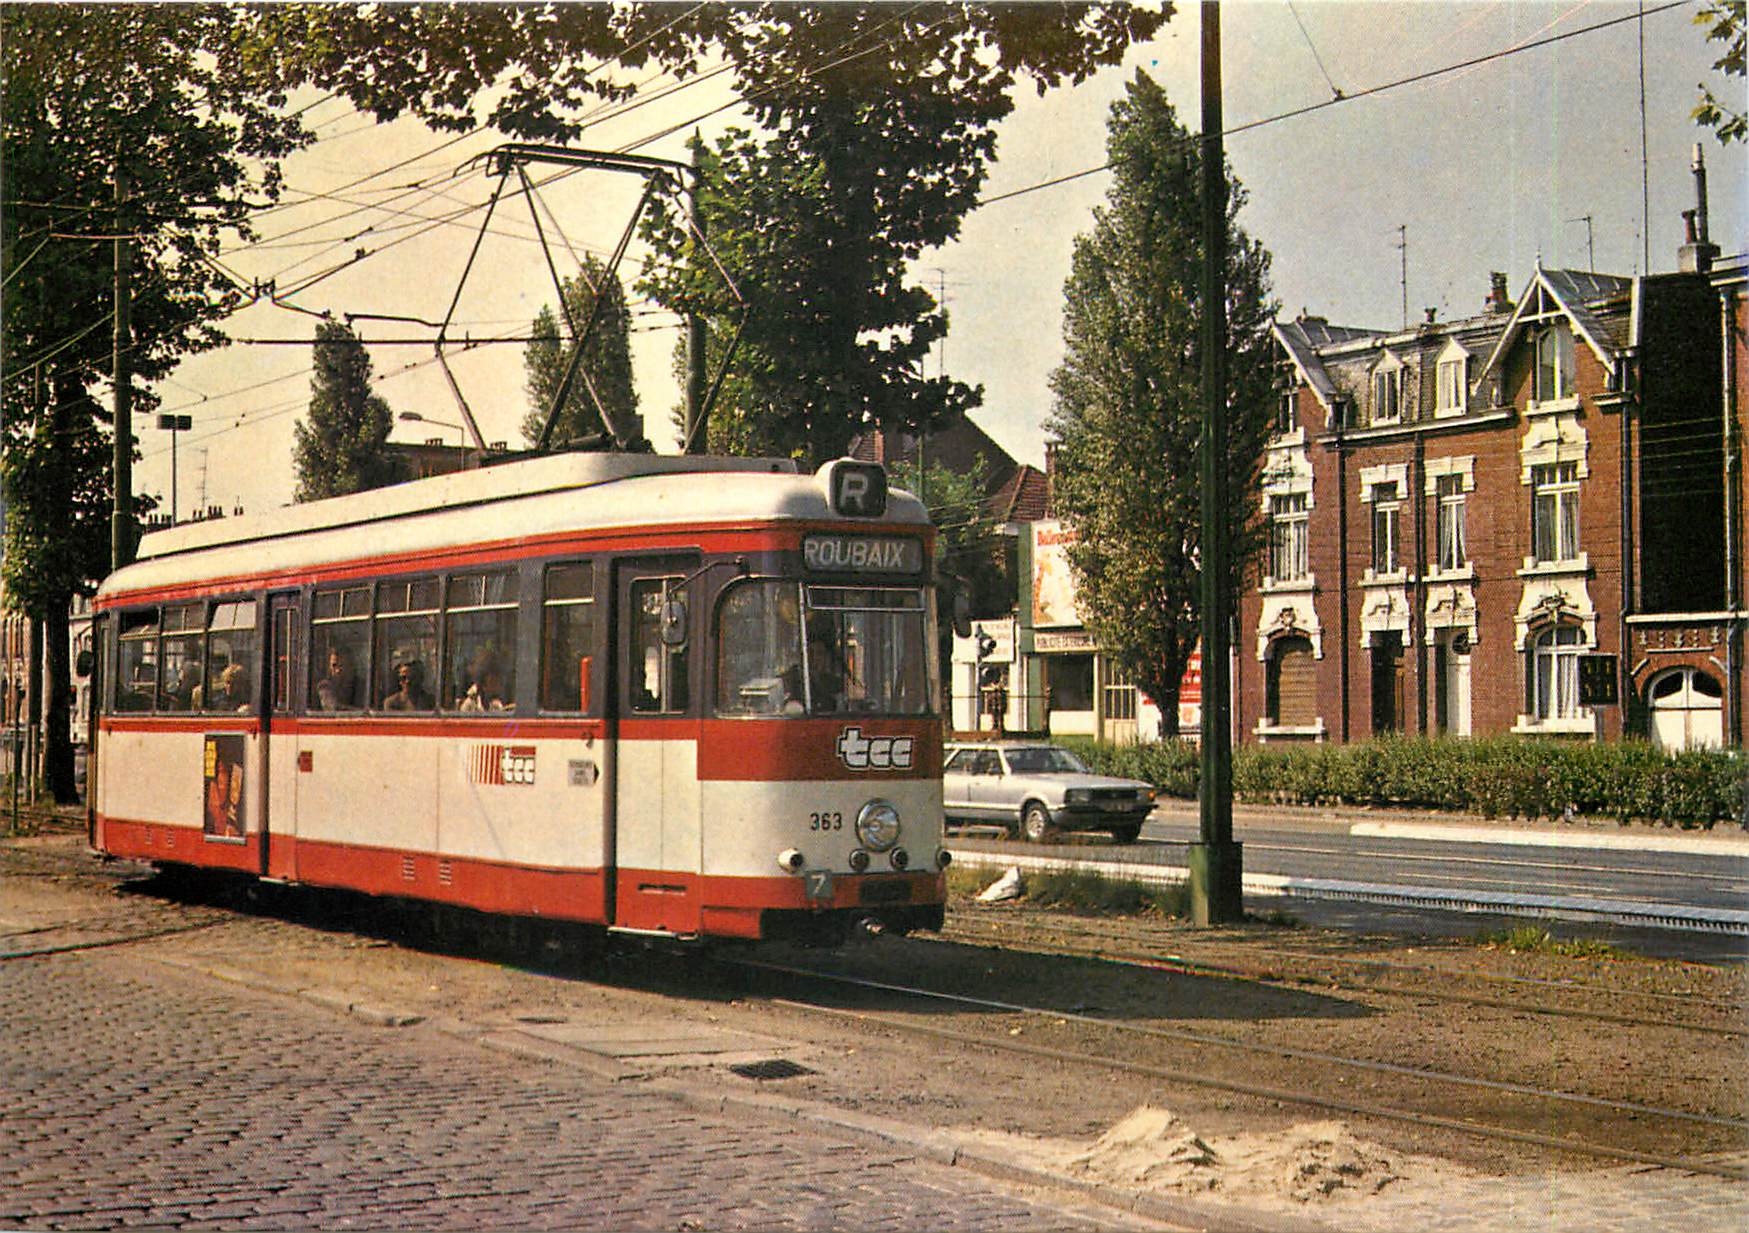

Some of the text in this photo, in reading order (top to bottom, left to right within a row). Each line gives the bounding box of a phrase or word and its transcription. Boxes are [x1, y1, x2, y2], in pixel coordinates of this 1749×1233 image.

[840, 473, 868, 510] R
[804, 540, 905, 568] ROUBAIX
[810, 813, 843, 831] 363
[811, 874, 826, 895] 7
